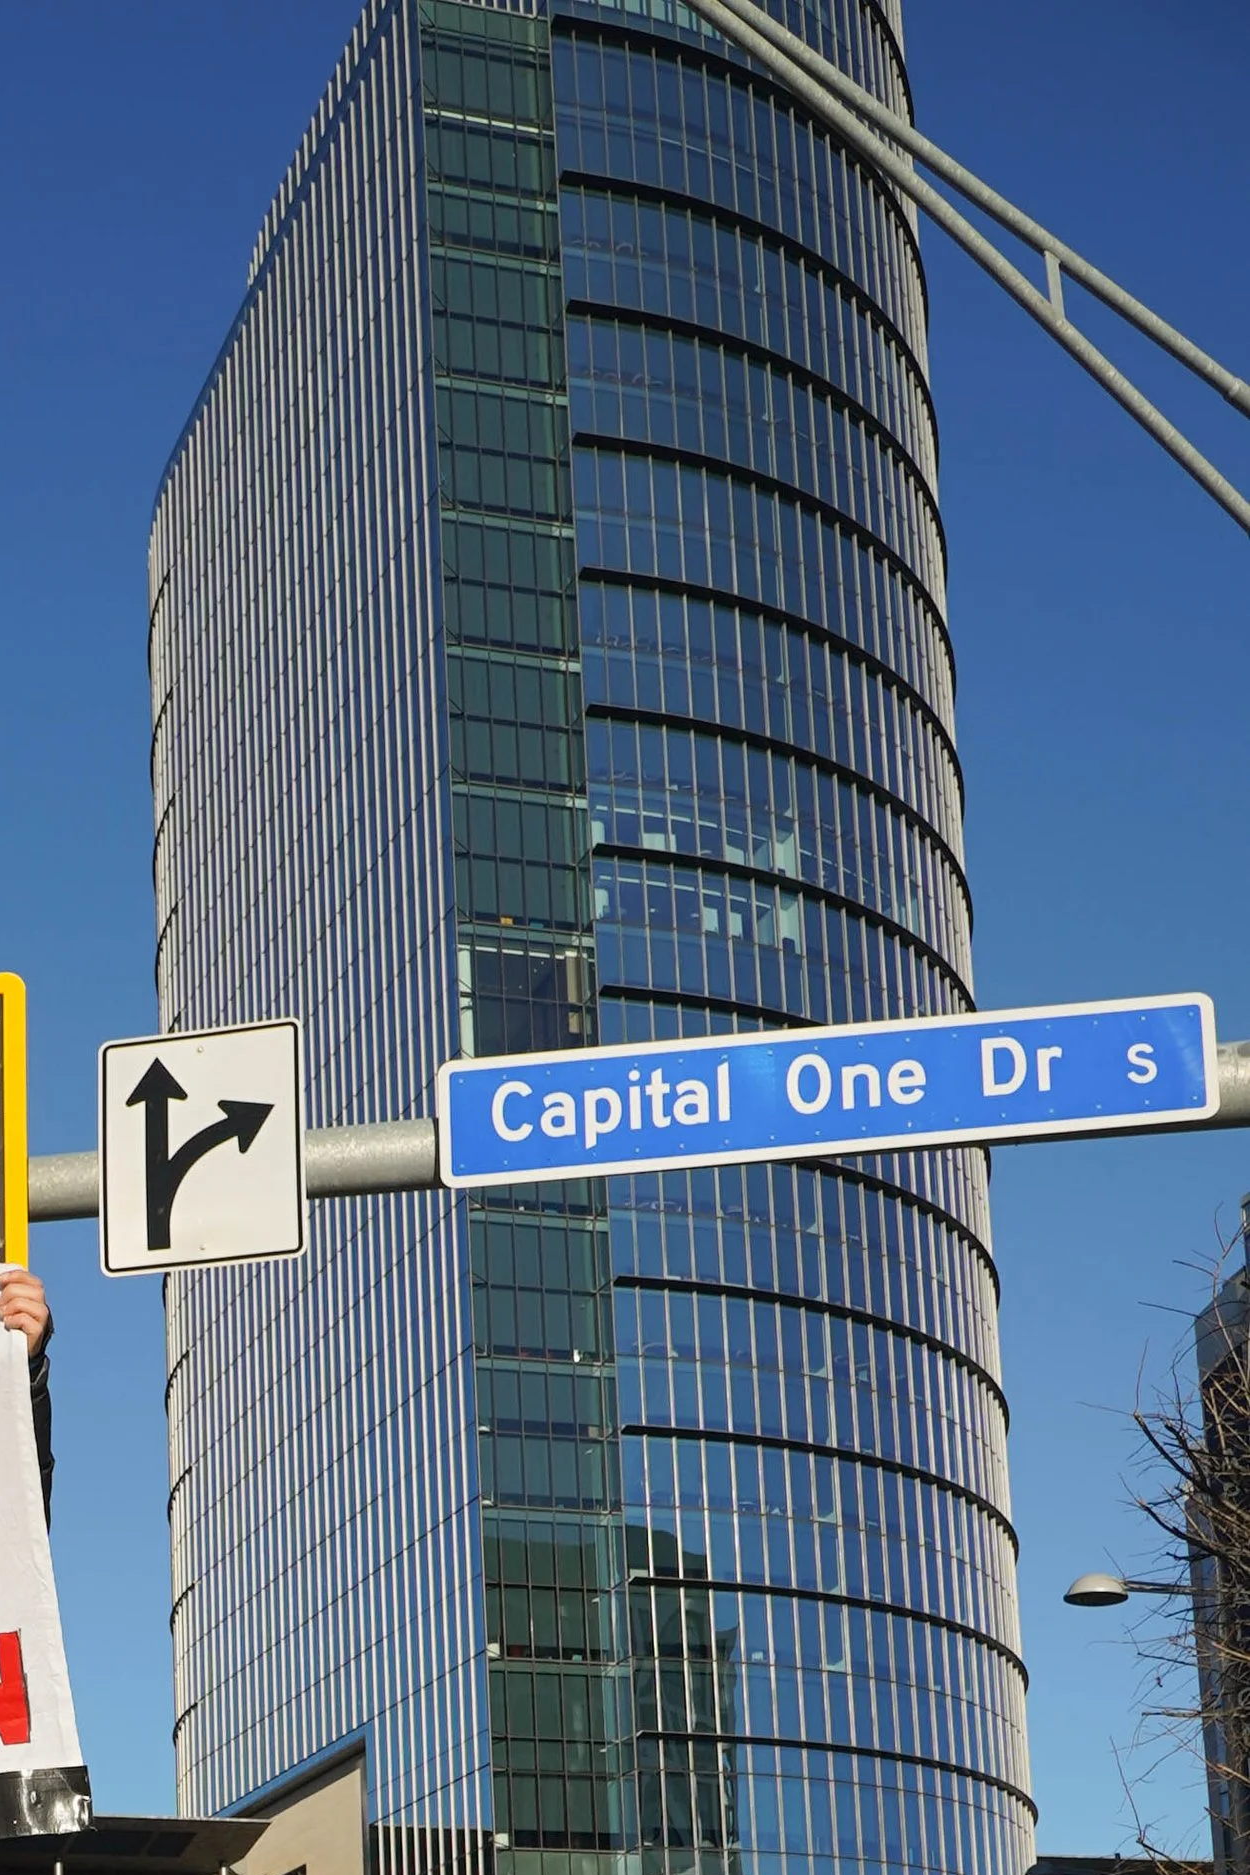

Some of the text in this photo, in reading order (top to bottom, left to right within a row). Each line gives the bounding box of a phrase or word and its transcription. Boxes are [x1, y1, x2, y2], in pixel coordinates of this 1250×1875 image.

[491, 1062, 731, 1149] Capital
[786, 1053, 926, 1114] One
[980, 1036, 1062, 1097] Dr
